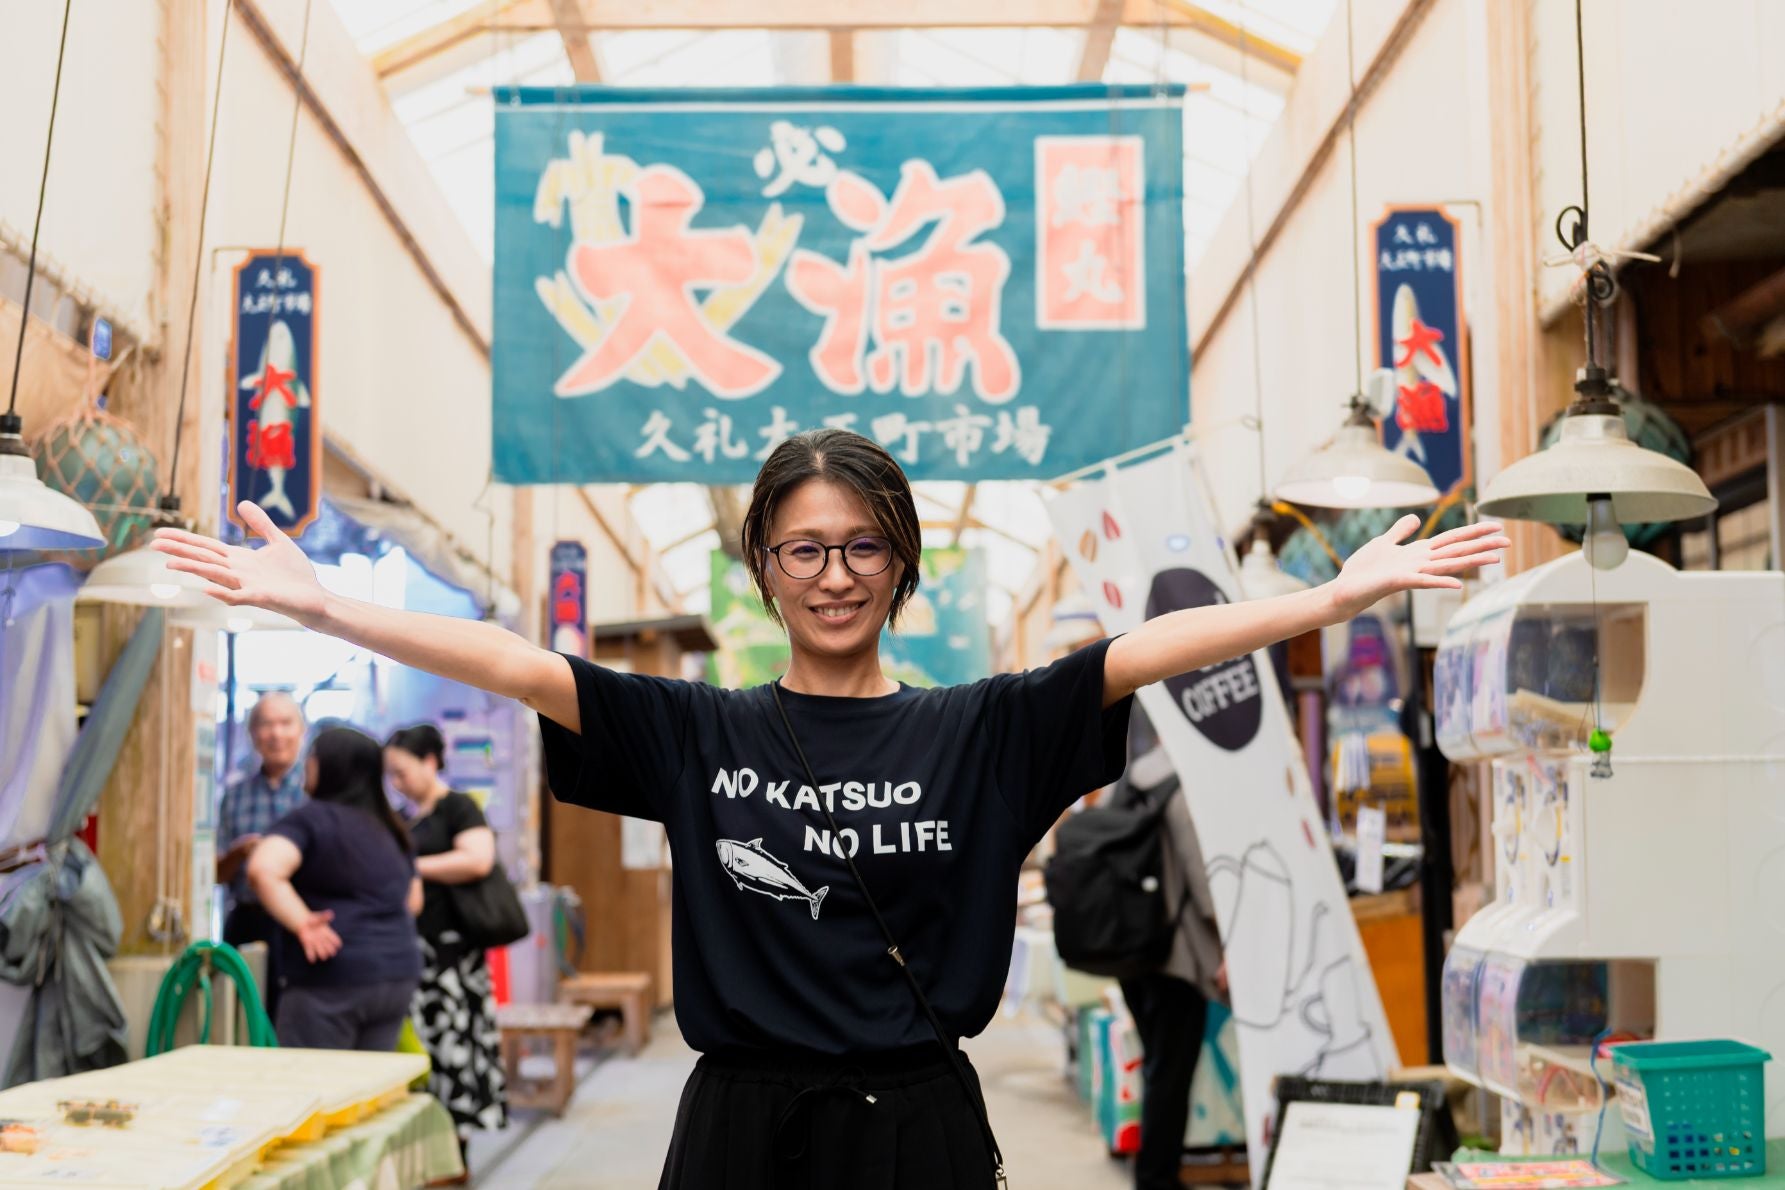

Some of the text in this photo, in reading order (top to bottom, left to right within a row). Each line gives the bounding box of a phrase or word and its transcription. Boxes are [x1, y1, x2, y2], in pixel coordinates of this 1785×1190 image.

[753, 120, 847, 198] 必
[555, 159, 1021, 402] 大漁
[1181, 660, 1259, 723] COFFEE
[711, 767, 921, 813] NO KATSUO
[804, 820, 952, 860] NO LIFE
